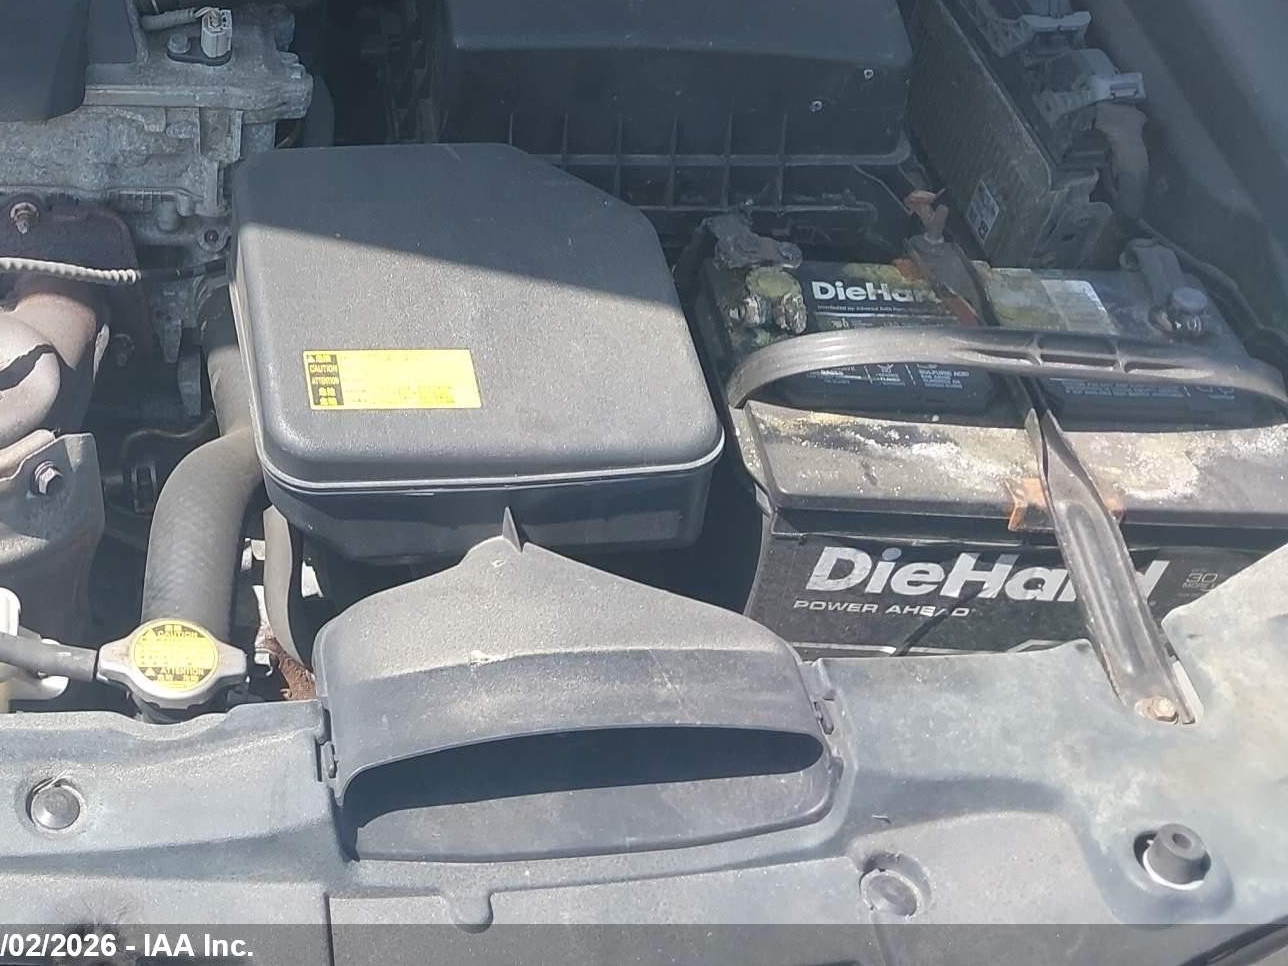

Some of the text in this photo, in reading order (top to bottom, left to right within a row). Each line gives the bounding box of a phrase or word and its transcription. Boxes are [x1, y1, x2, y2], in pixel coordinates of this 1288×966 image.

[310, 364, 338, 373] CAUTION
[311, 376, 340, 385] ATTENTION
[793, 600, 878, 614] POWER
[157, 630, 198, 638] CAUTION
[160, 666, 205, 676] ATTENTION
